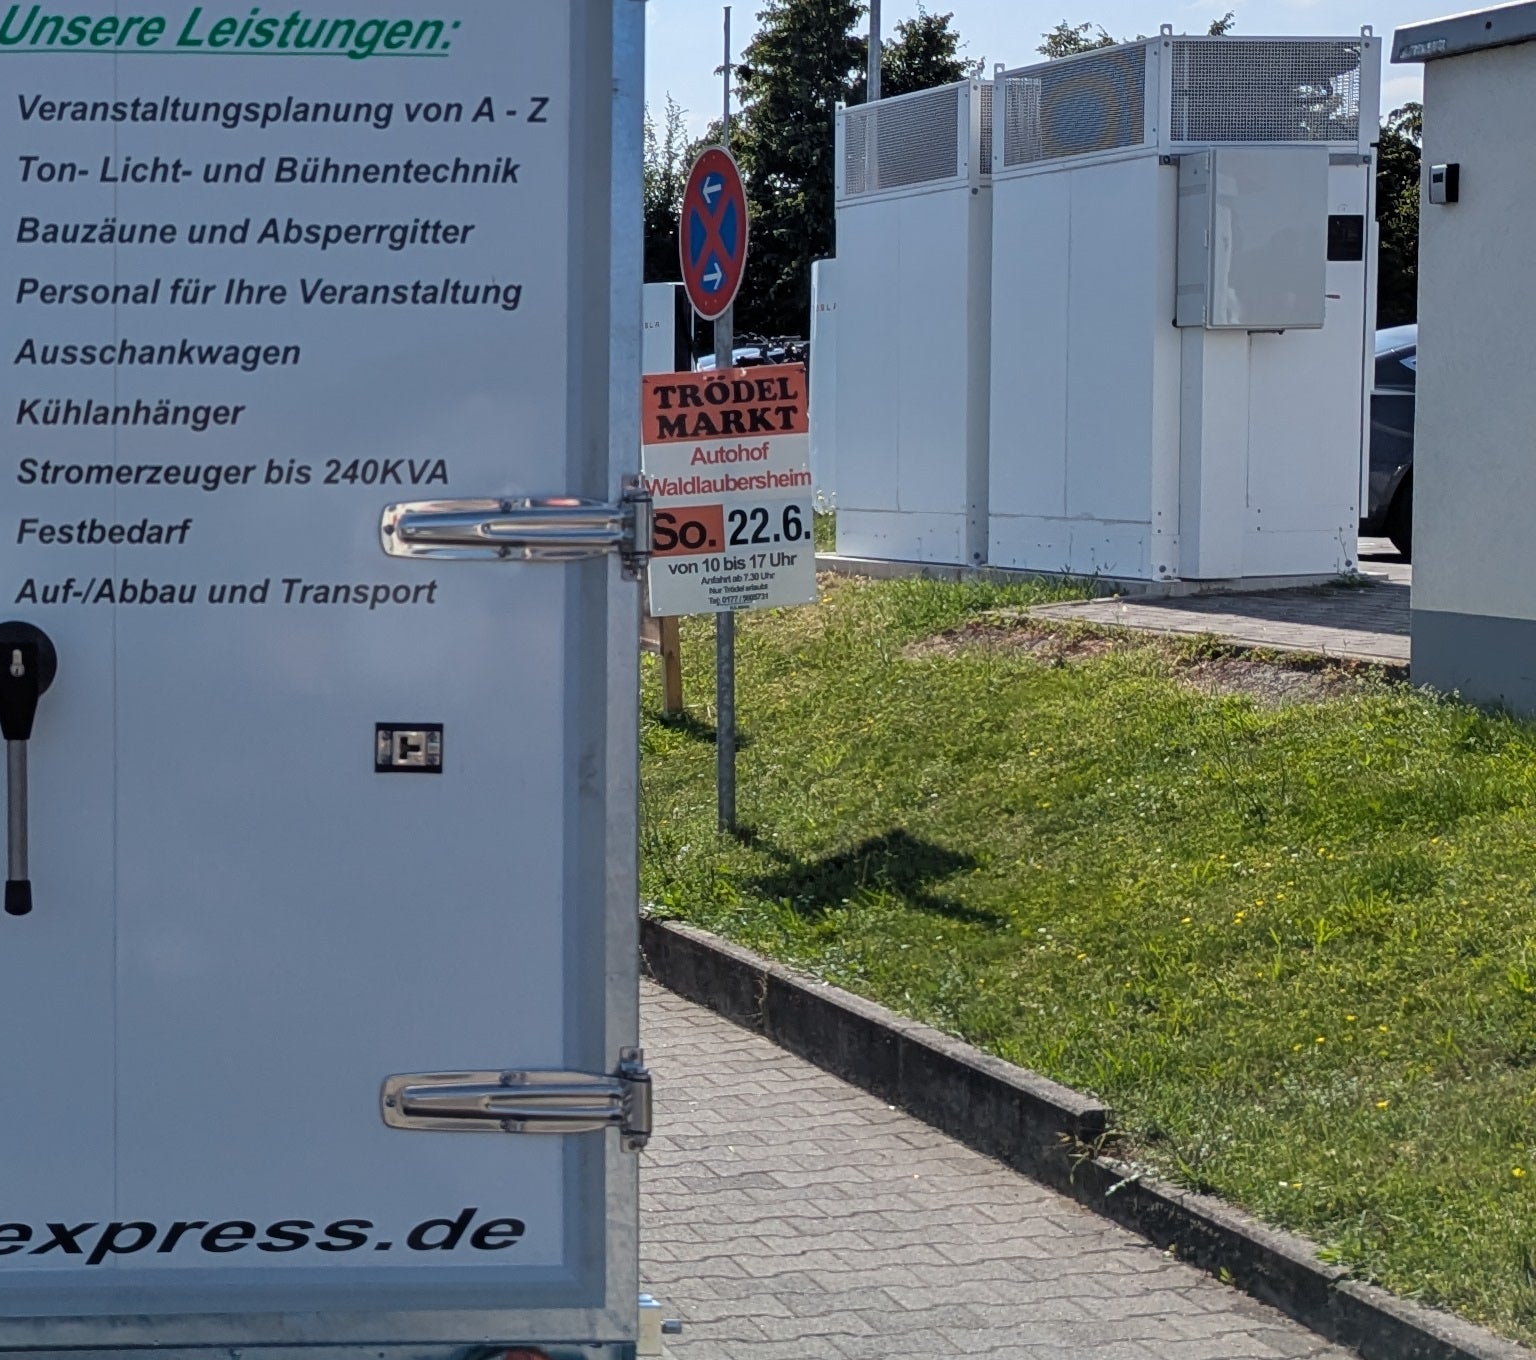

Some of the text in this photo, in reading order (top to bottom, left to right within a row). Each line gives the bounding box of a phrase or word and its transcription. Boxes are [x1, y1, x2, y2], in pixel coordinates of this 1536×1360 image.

[176, 7, 461, 60] Leistungen:
[19, 95, 393, 129] Veranstaltungsplanung
[405, 103, 462, 122] von
[472, 97, 494, 122] A
[527, 97, 549, 122] Z
[19, 156, 88, 182] Ton-
[100, 157, 192, 183] Licht-
[204, 157, 265, 183] und
[275, 157, 520, 183] Bühnentechnik
[17, 217, 176, 243] Bauzäune
[188, 218, 250, 244] und
[257, 218, 475, 251] Absperrgitter
[16, 278, 160, 304] Personal
[170, 278, 216, 304] für
[225, 279, 286, 304] Ihre
[301, 279, 522, 311] Veranstaltung
[14, 339, 300, 371] Ausschankwagen
[653, 375, 798, 409] TRÖDEL
[17, 399, 245, 431] Kühlanhänger
[656, 405, 798, 439] MARKT
[690, 442, 770, 465] Autohof
[17, 459, 256, 491] Stromerzeuger
[265, 459, 311, 484] bis
[324, 459, 447, 484] 240KVA
[644, 469, 812, 497] Waldlaubersheim
[17, 519, 192, 544] Festbedarf
[653, 505, 811, 551] So. 22.6.
[668, 552, 797, 575] von 10 bis 17 Uhr
[701, 575, 731, 585] Anfahrt
[761, 572, 775, 580] Uhr
[15, 578, 196, 604] Auf-/Abbau
[209, 579, 270, 603] und
[282, 579, 437, 609] Transport
